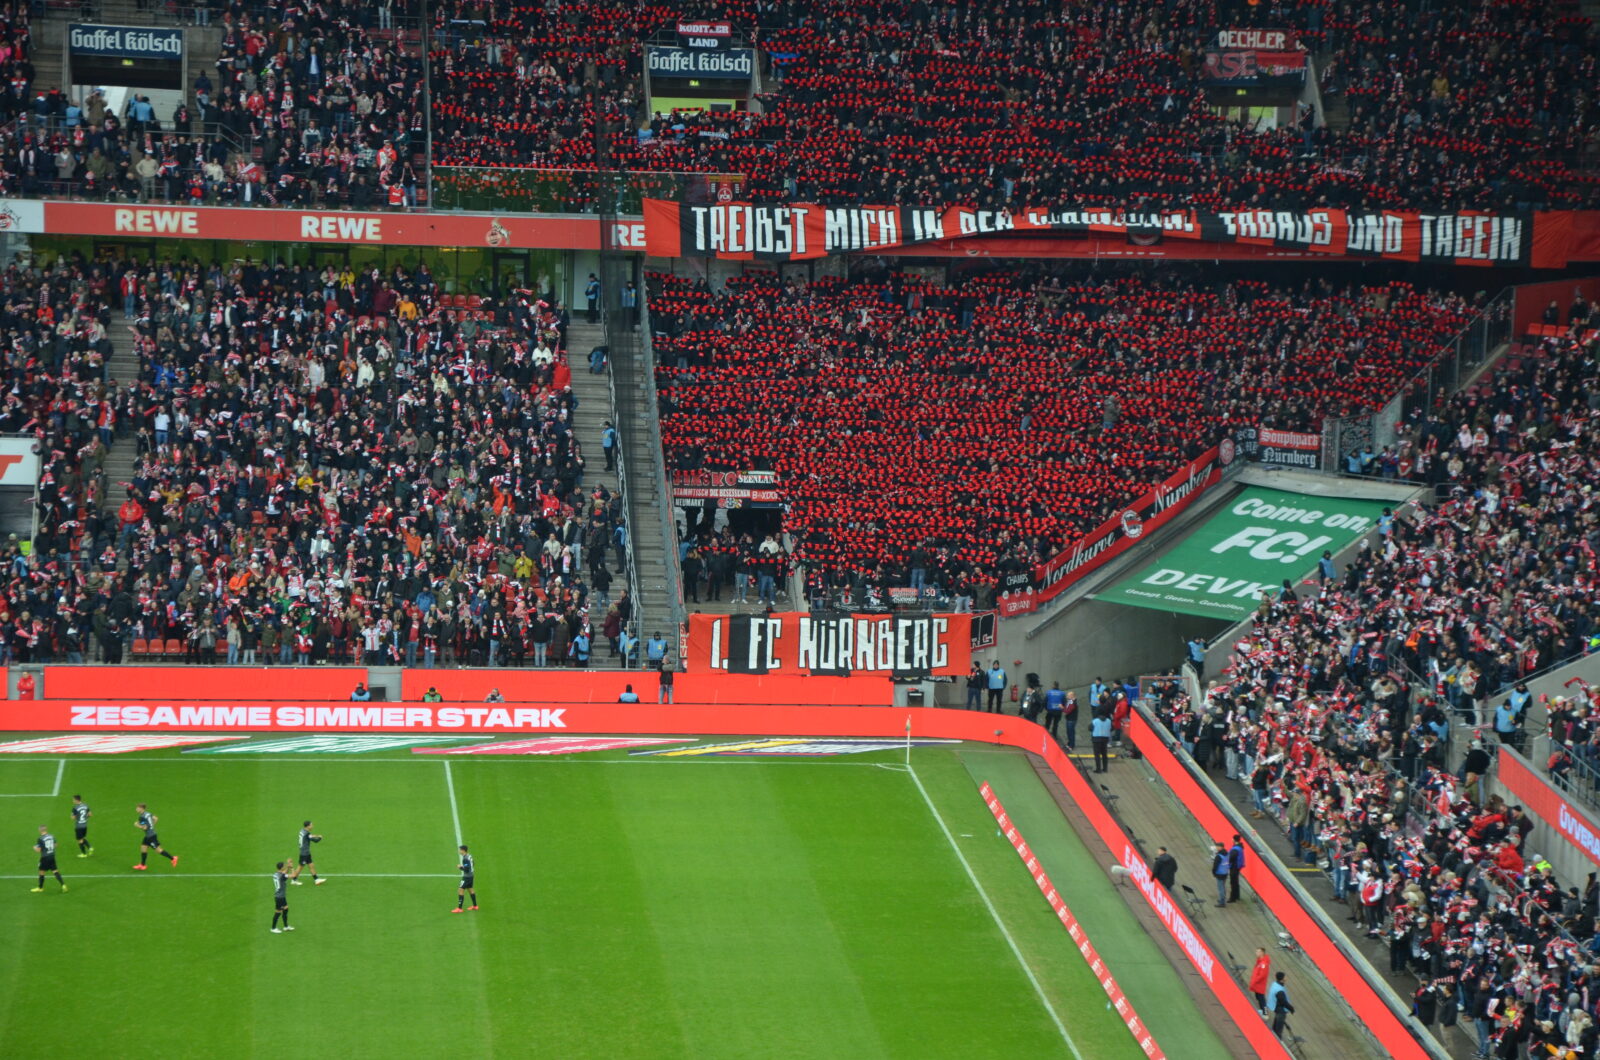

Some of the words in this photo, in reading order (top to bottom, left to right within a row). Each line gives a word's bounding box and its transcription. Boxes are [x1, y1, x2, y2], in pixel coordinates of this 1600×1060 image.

[71, 28, 124, 51] Gaffel
[125, 31, 182, 55] Kölsch
[688, 37, 719, 48] LAND
[1218, 30, 1286, 49] OECHLER
[648, 51, 696, 72] Gaffel
[699, 52, 751, 75] Kölsch
[115, 208, 199, 234] REWE
[301, 215, 382, 241] REWE
[691, 205, 809, 254] TREIBST
[825, 207, 897, 251] MICH
[912, 209, 945, 241] IN
[1347, 213, 1404, 253] UND
[1261, 446, 1317, 468] Nürnberg
[675, 498, 705, 507] NEUMARKT
[1150, 463, 1213, 519] Nürnberg
[1232, 498, 1324, 525] Come
[1322, 512, 1371, 534] on,
[1210, 526, 1333, 564] FC!
[1038, 531, 1116, 593] Nordkurve
[1006, 573, 1029, 586] CHAMPS
[1141, 568, 1280, 602] DEVK
[711, 618, 729, 669] 1.
[749, 617, 782, 670] FC
[799, 617, 950, 671] NÜRNBERG
[69, 705, 272, 728] ZESAMME
[276, 706, 432, 728] SIMMER
[437, 708, 567, 729] STARK
